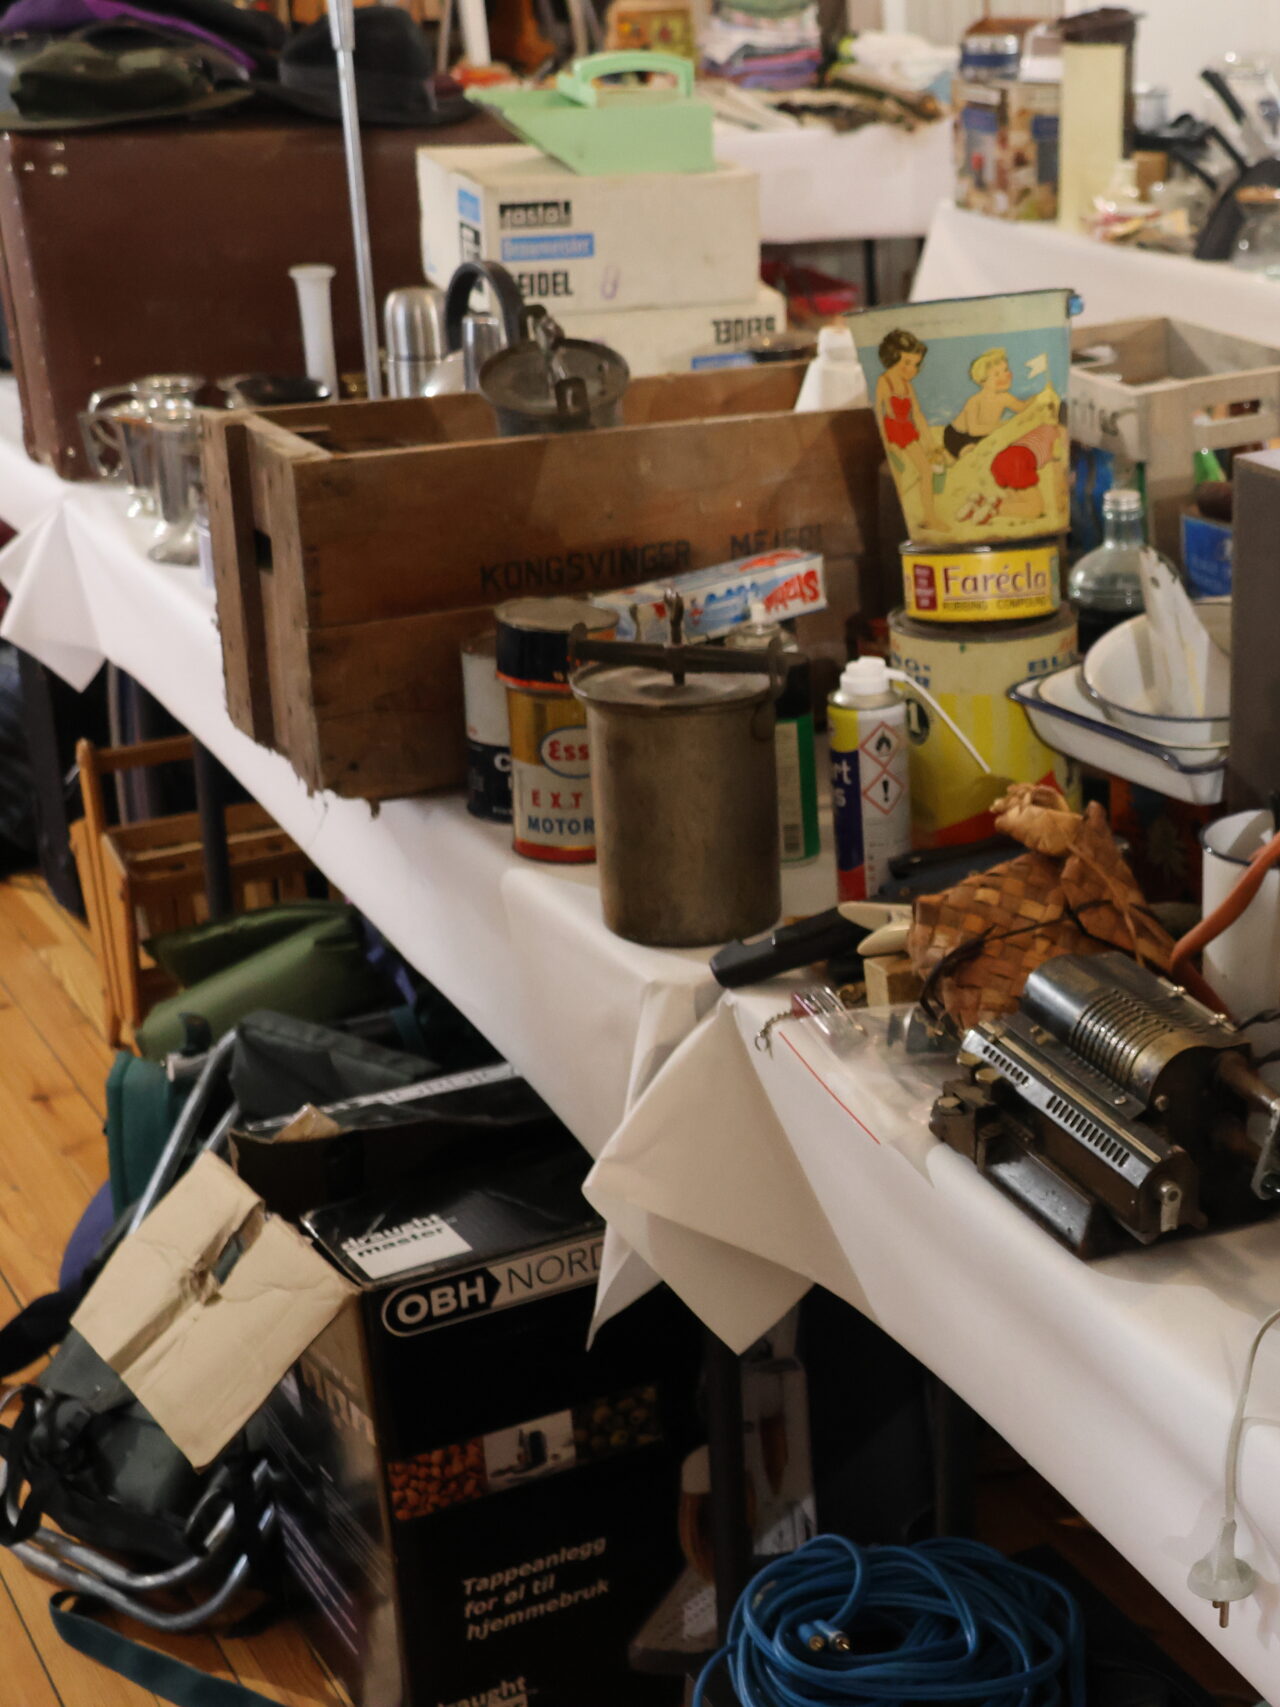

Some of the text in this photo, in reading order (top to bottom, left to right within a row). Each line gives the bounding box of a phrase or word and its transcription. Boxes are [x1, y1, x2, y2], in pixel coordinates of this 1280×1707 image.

[514, 271, 573, 297] EIDEL
[481, 540, 691, 591] KONGSVINGER
[944, 563, 1047, 595] Farécla
[528, 815, 594, 835] MOTOR
[396, 1274, 487, 1326] OBH
[463, 1537, 606, 1596] Tappeanlegg
[465, 1597, 499, 1619] for
[533, 1573, 556, 1595] til
[467, 1579, 608, 1641] hjemmebruk
[437, 1676, 526, 1707] aught
